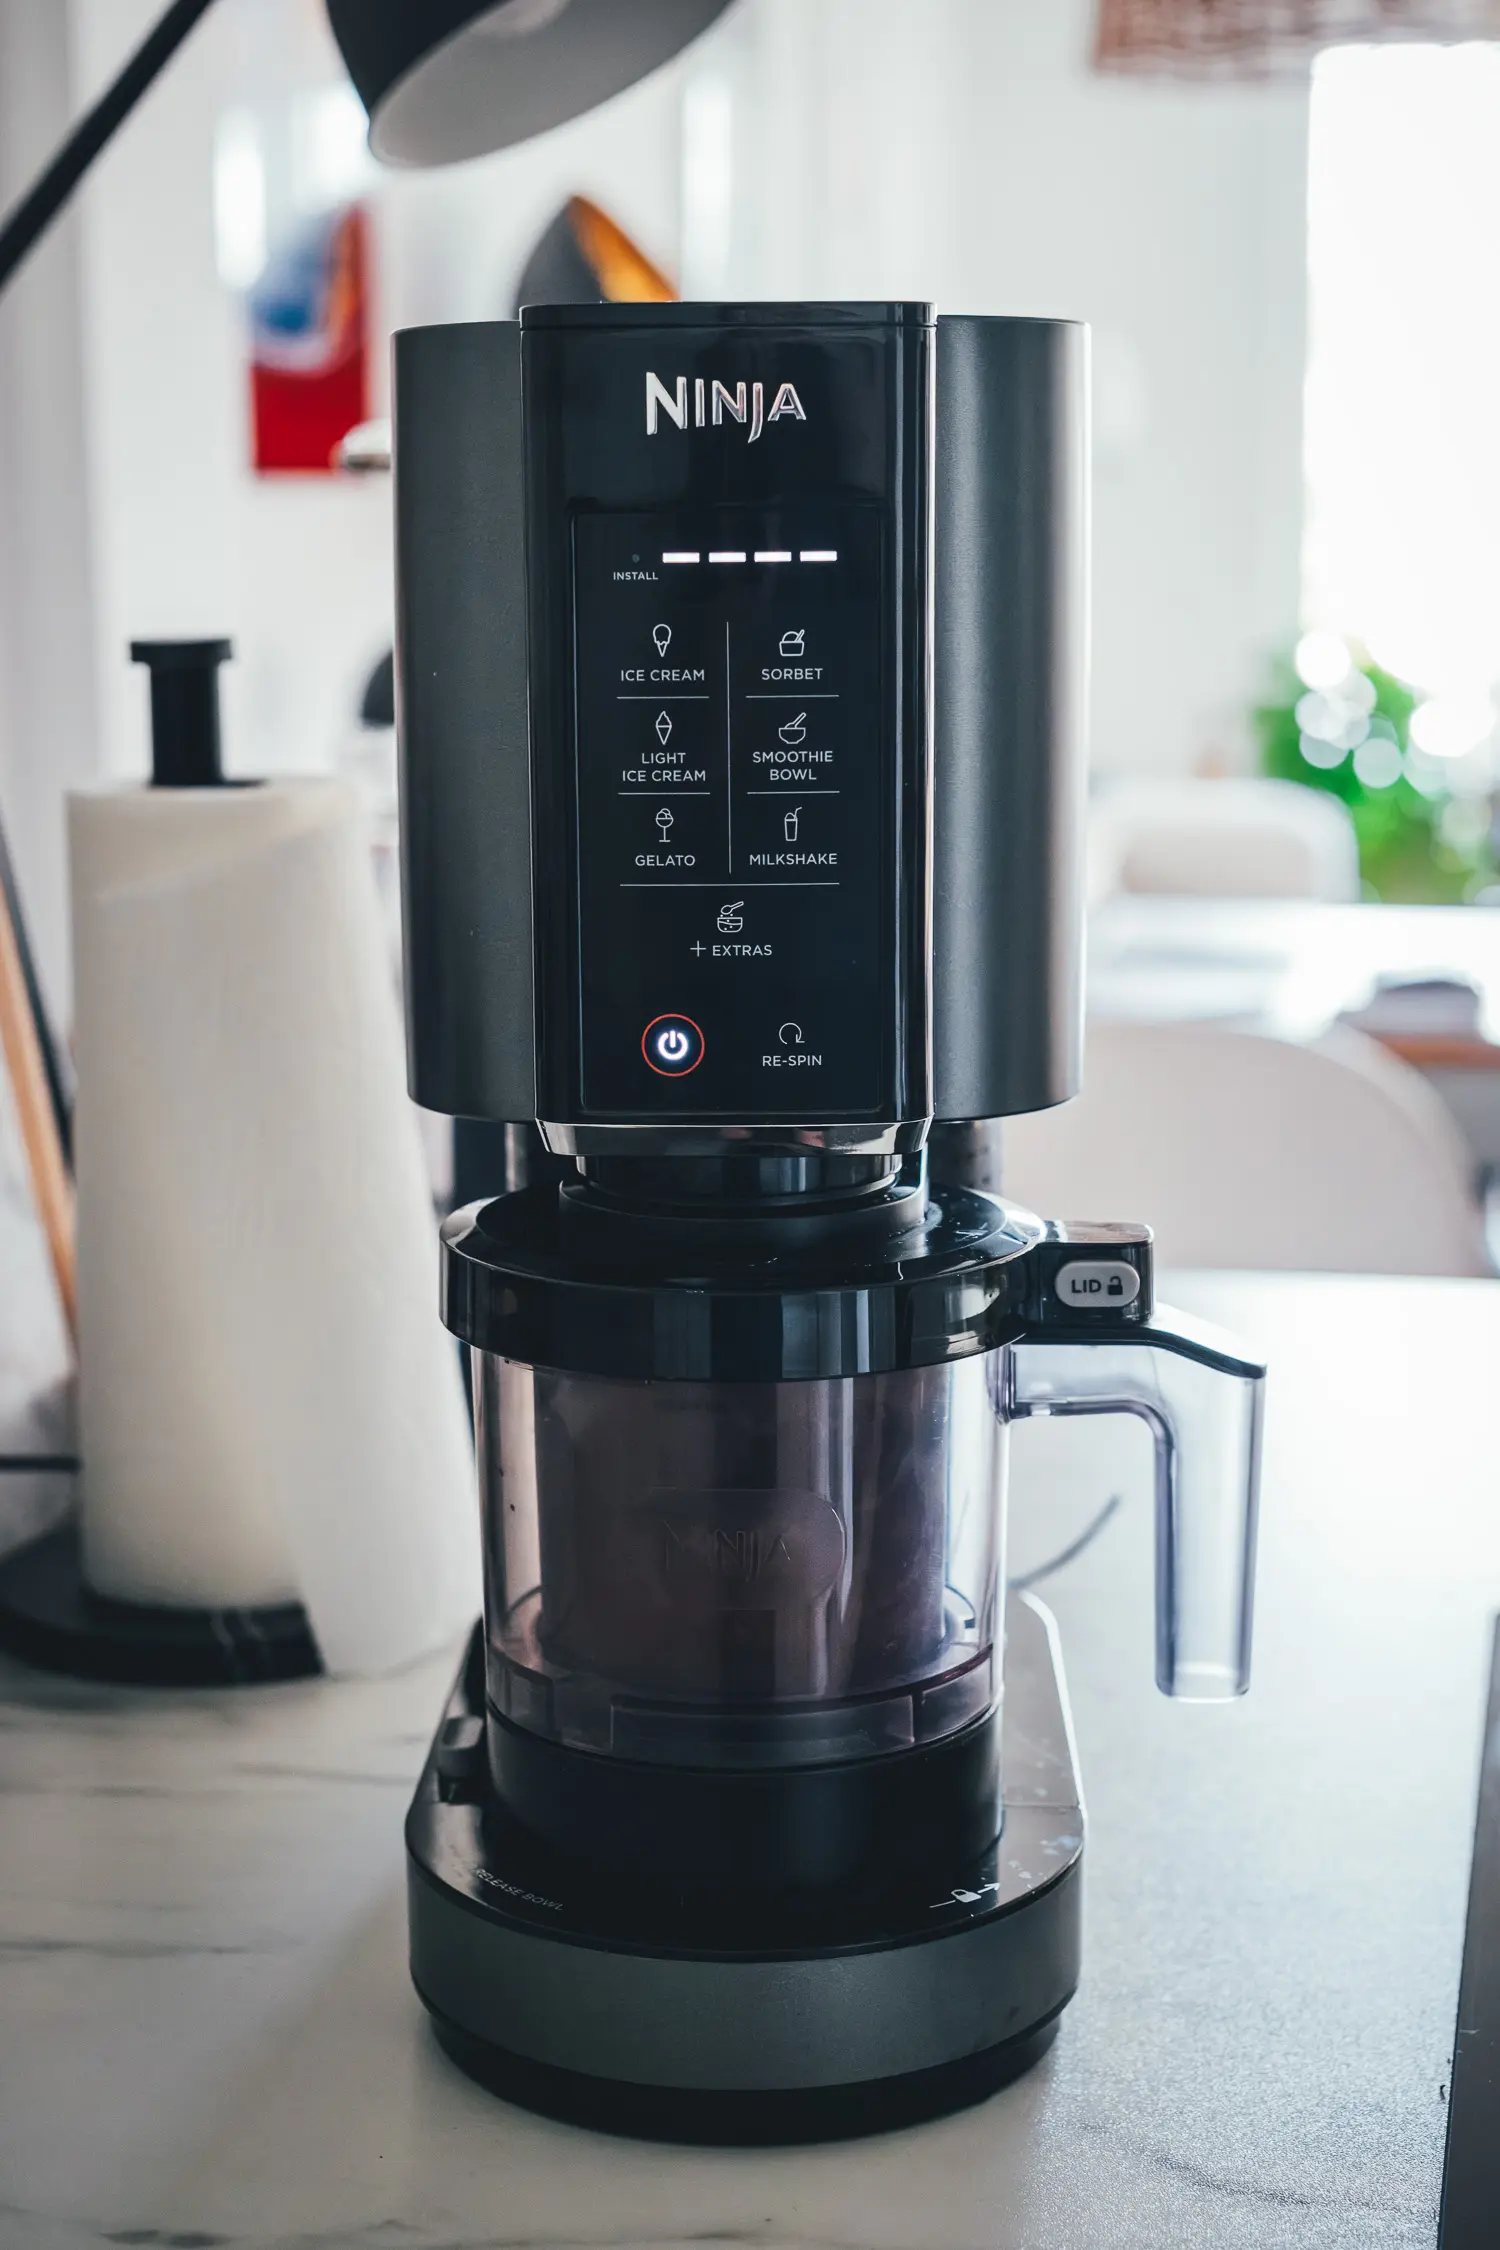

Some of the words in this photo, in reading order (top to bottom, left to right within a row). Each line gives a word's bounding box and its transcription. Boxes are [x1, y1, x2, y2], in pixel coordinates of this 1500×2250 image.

[646, 371, 807, 444] NINJA
[613, 571, 659, 581] INSTALL
[620, 669, 646, 682] ICE
[649, 669, 705, 682] CREAM
[761, 667, 824, 681] SORBET
[641, 752, 687, 765] LIGHT
[752, 750, 834, 764] SMOOTHIE
[622, 770, 647, 782] ICE
[651, 769, 706, 782] CREAM
[769, 768, 817, 781] BOWL
[634, 854, 696, 867] GELATO
[749, 852, 838, 866] MILKSHAKE
[712, 944, 773, 957] EXTRAS
[762, 1054, 822, 1067] RE-SPIN
[1071, 1279, 1102, 1294] LID
[660, 1519, 791, 1583] NNJA
[476, 1868, 525, 1896] RELEASE
[521, 1892, 564, 1911] BOWL
